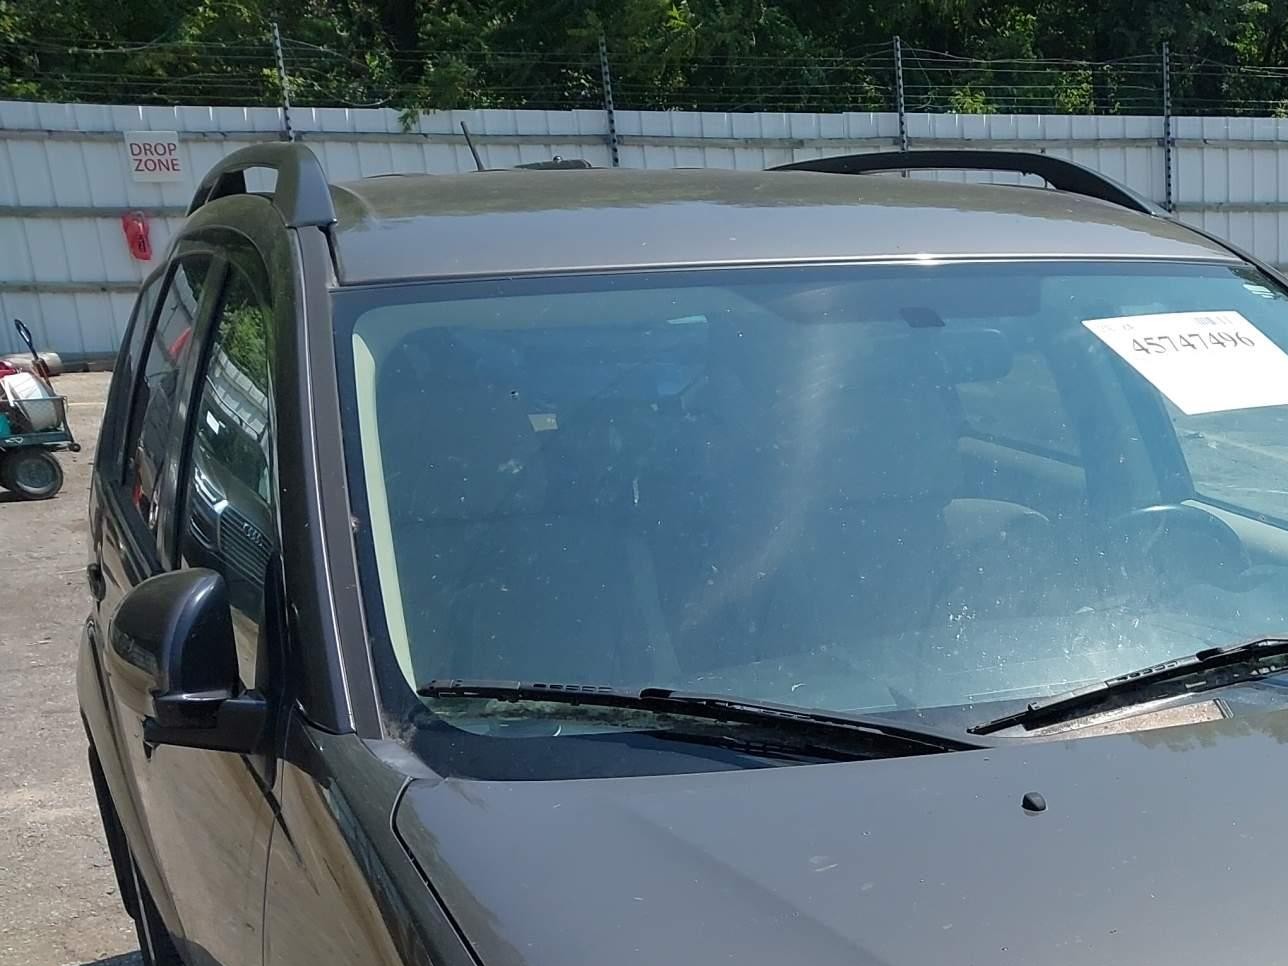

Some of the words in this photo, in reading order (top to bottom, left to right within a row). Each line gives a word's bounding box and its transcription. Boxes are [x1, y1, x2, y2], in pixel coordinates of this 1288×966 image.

[129, 142, 177, 156] DROP
[133, 158, 181, 172] ZONE
[1132, 331, 1255, 354] 45747496
